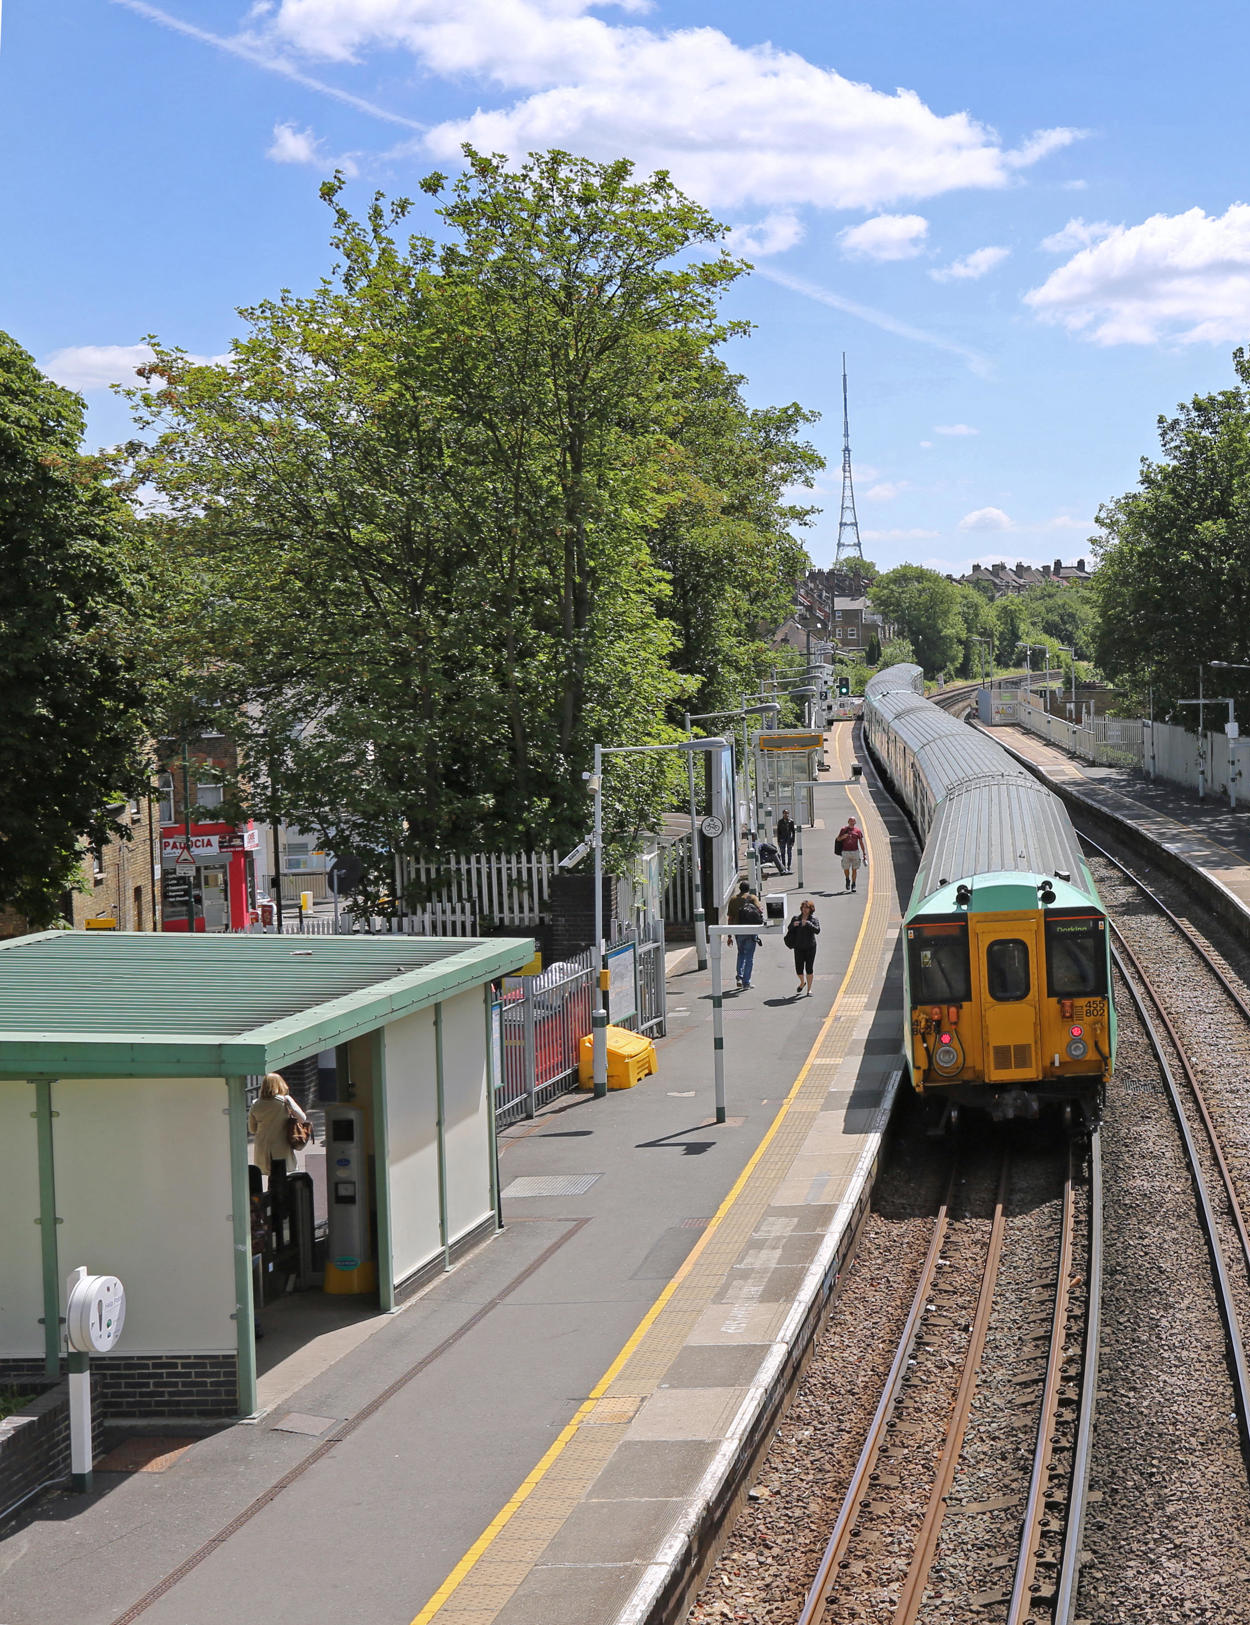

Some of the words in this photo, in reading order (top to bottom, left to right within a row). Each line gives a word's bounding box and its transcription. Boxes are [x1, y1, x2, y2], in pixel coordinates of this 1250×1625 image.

[821, 692, 826, 700] 2
[1085, 1000, 1105, 1009] 455
[1085, 1009, 1105, 1017] 802
